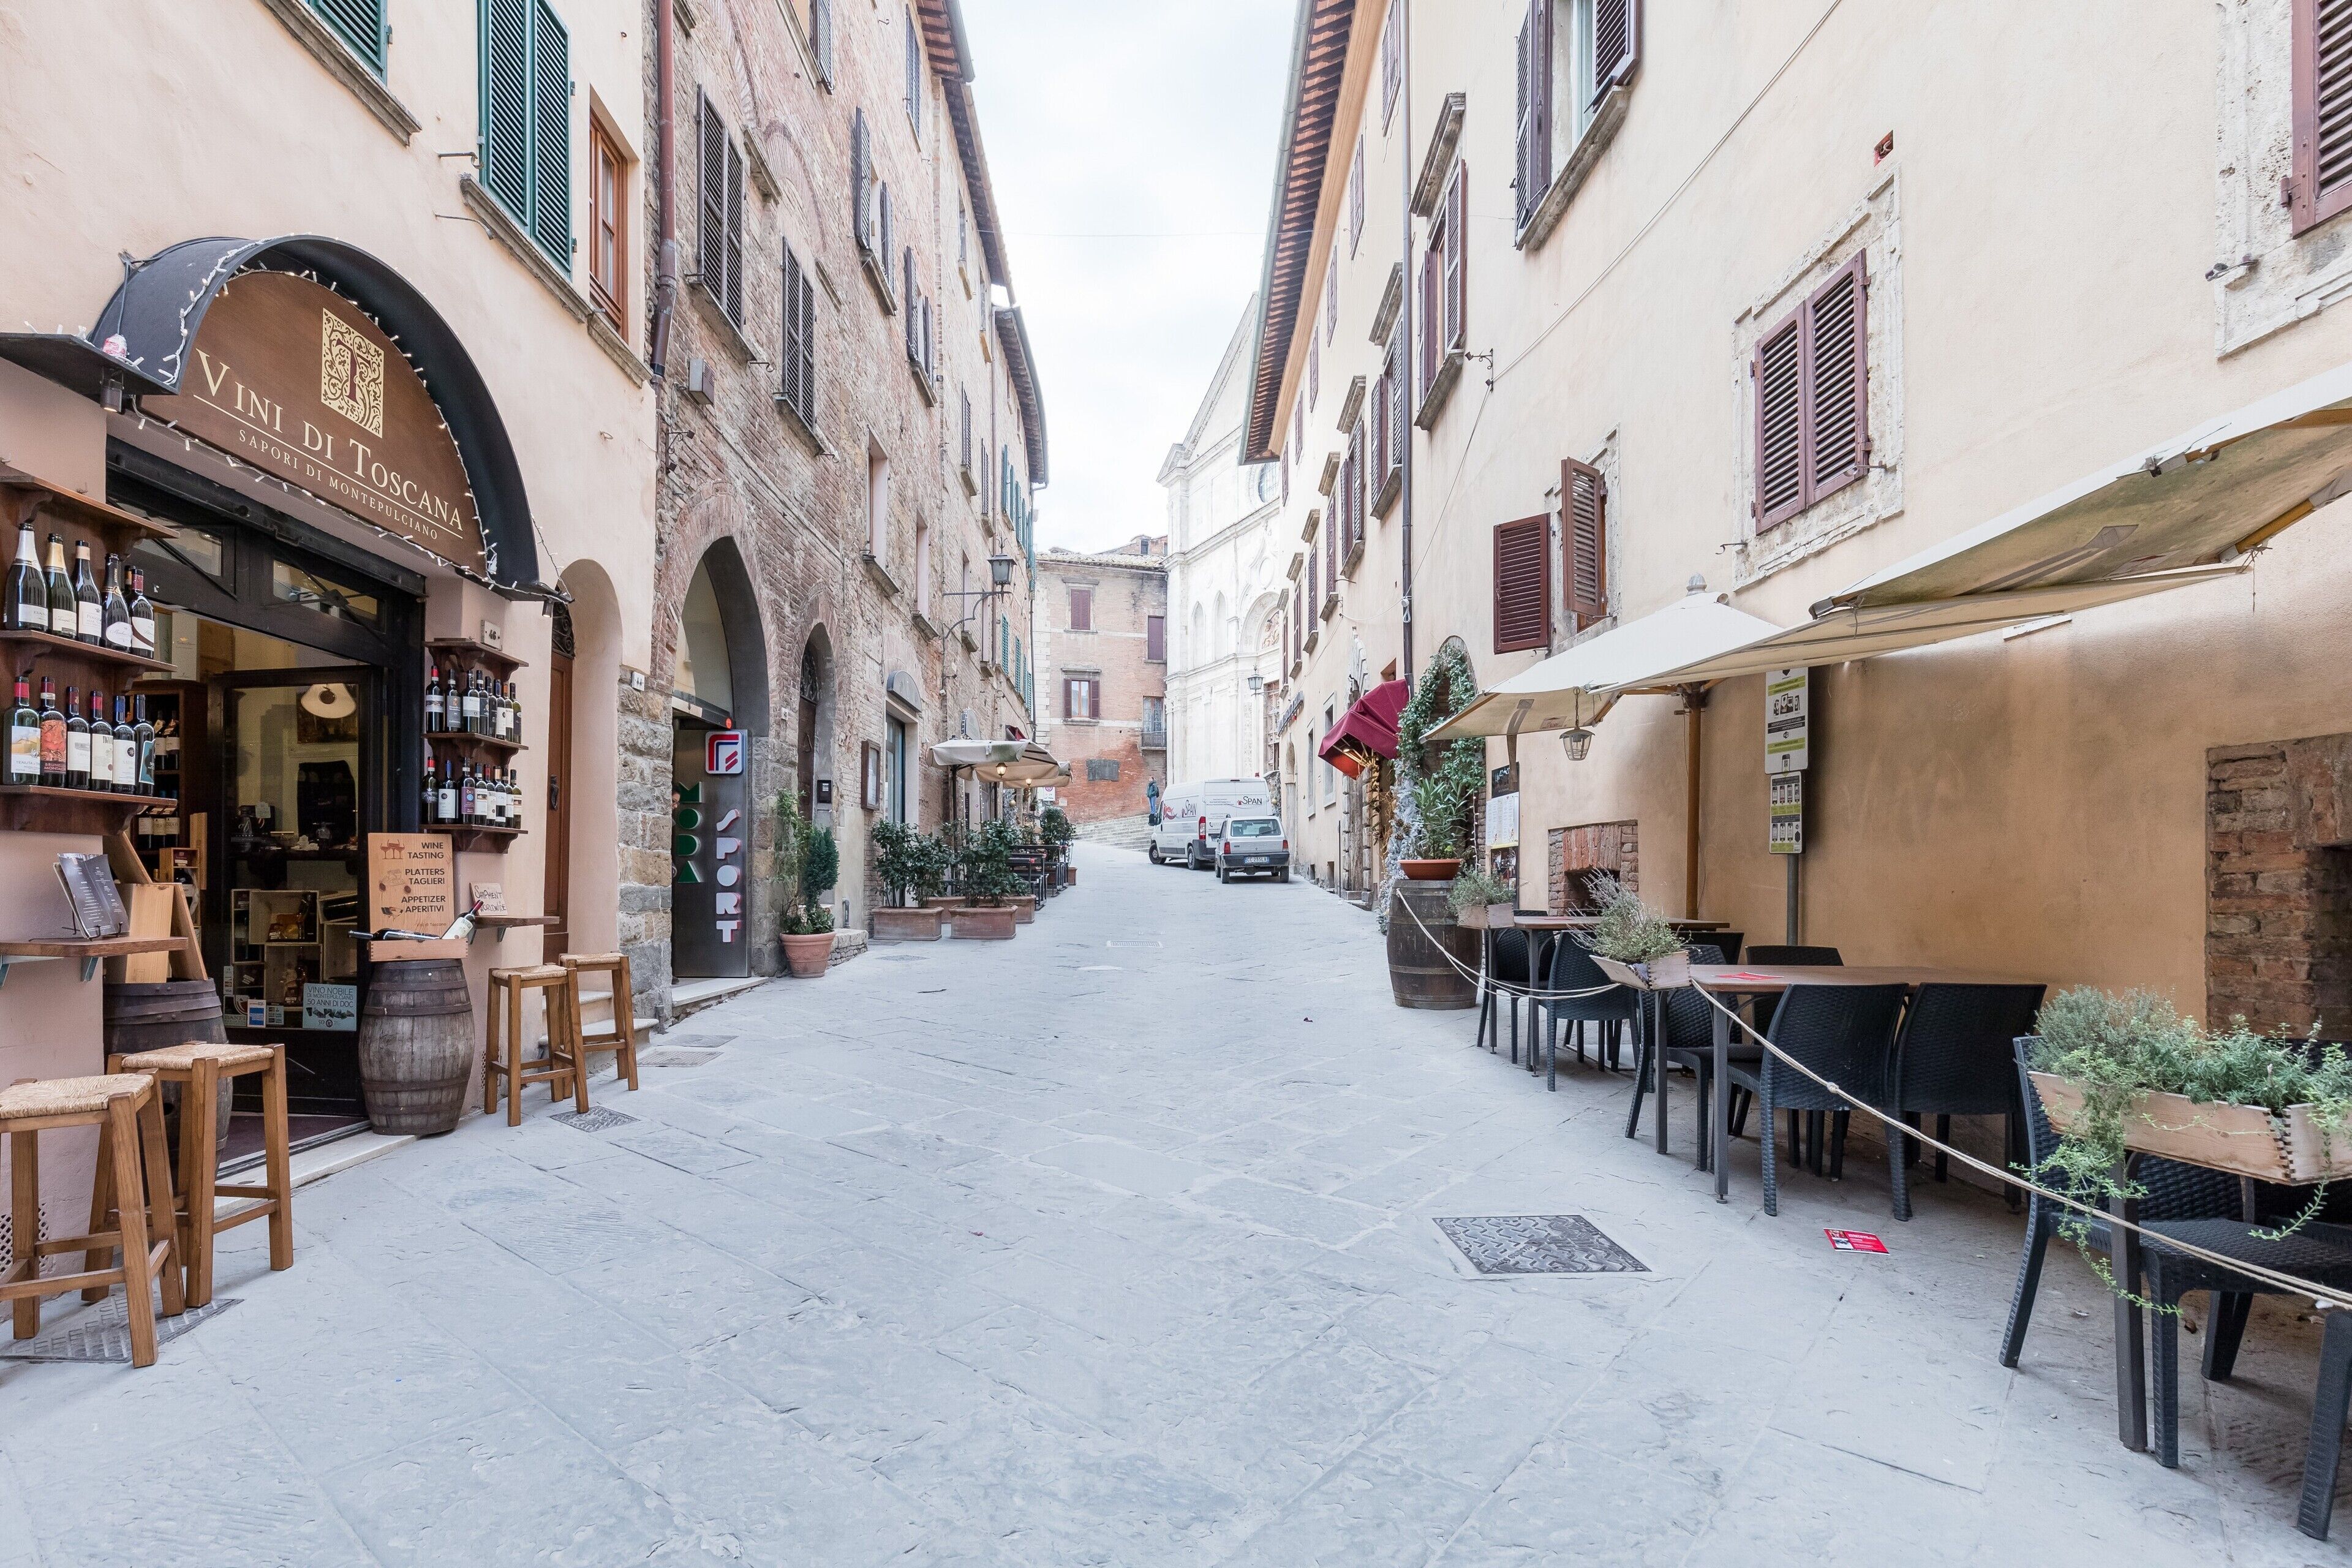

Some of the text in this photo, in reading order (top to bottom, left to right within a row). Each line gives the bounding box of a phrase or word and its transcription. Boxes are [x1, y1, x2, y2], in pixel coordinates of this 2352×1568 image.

[239, 429, 437, 540] SAPORI DI MONTEPULCIANO
[303, 421, 334, 461] DI
[349, 438, 463, 531] TOSCANA
[489, 629, 496, 640] 46
[677, 781, 703, 883] MODA
[1185, 799, 1197, 816] SPAN
[1243, 796, 1262, 805] SPAN
[716, 809, 741, 943] SPORT
